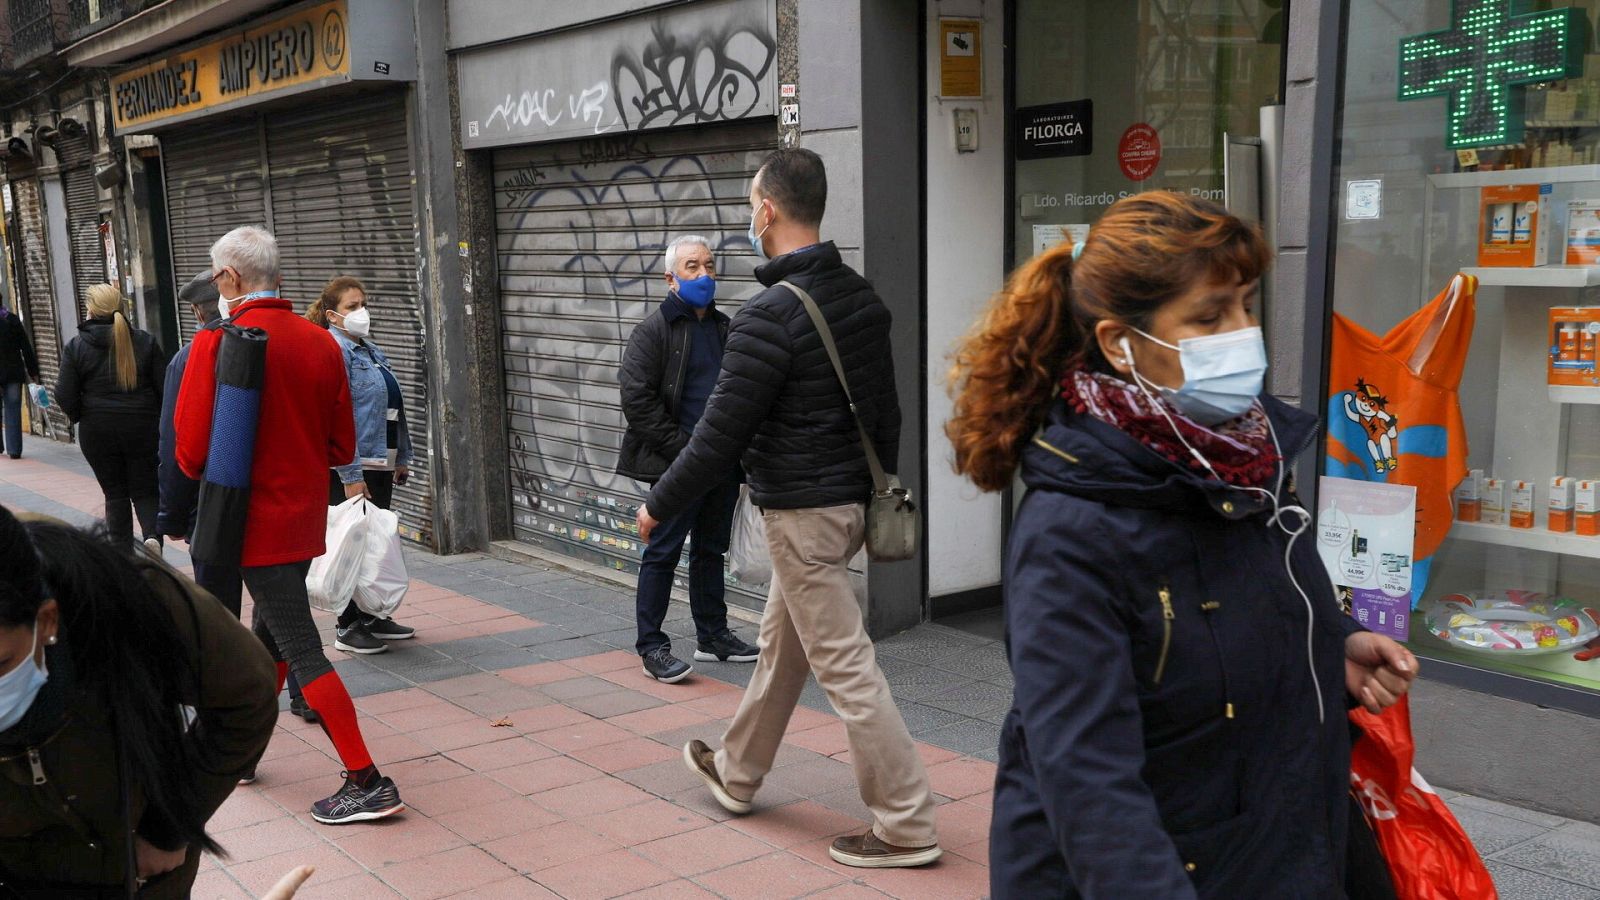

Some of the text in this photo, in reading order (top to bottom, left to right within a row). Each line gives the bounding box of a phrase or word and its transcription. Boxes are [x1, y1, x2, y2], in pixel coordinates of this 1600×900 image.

[115, 20, 342, 122] FERNANDEZ AMPUERO 42
[1024, 122, 1084, 141] FILORGA
[1033, 193, 1061, 208] Ldo.
[1064, 191, 1115, 207] Ricardo
